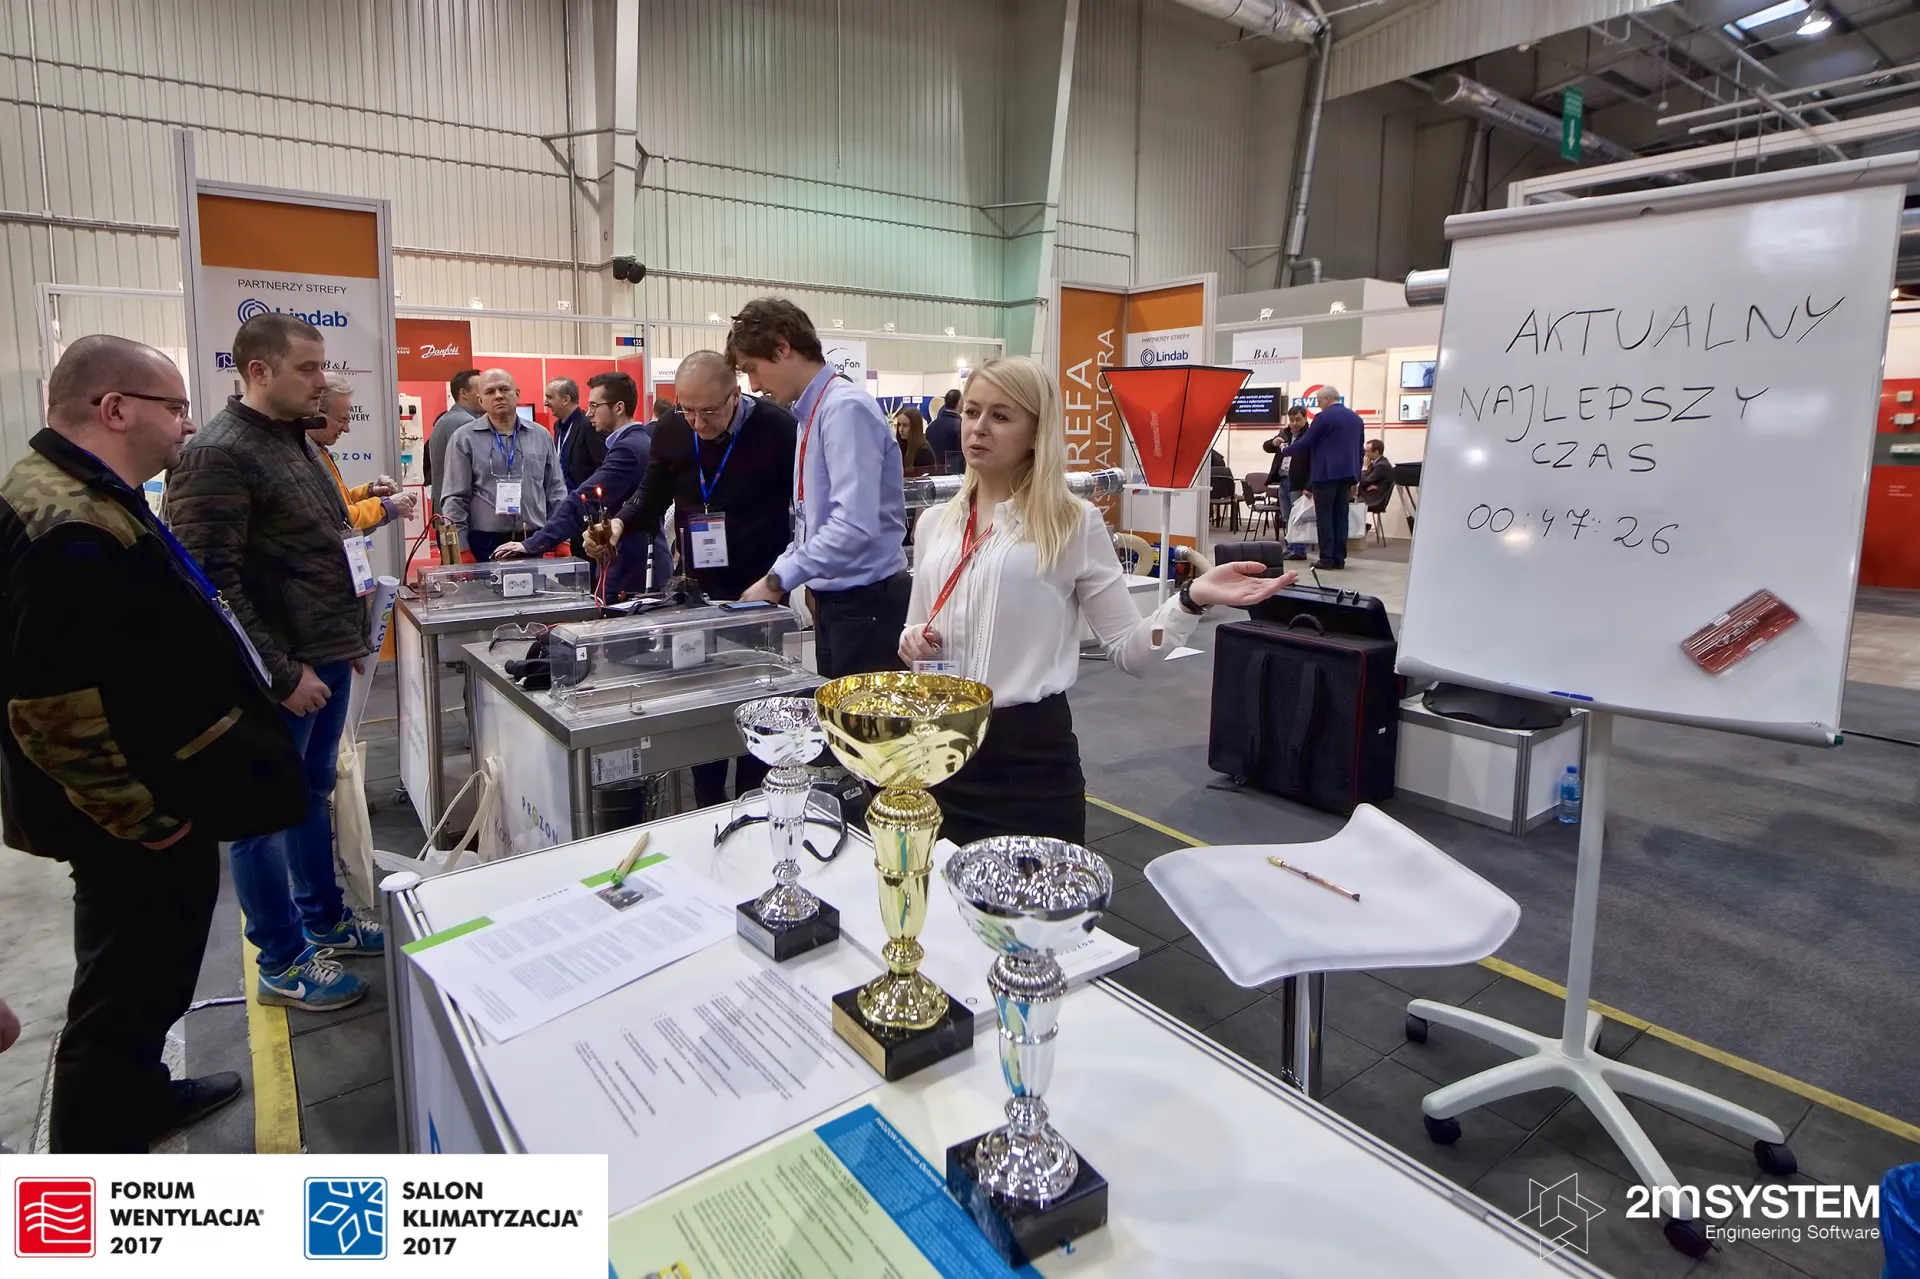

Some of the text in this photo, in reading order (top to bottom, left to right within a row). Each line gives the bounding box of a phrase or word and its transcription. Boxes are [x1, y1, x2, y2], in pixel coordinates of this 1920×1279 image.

[237, 278, 347, 295] PARTNERZY STREFY
[276, 307, 348, 327] ndab
[1504, 295, 1846, 356] AKTUALNY
[420, 343, 459, 359] Danfoss
[1156, 350, 1189, 362] Lindab
[1253, 349, 1262, 359] B
[1458, 384, 1769, 443] NAJLEPSZY
[1531, 441, 1658, 473] CZAS
